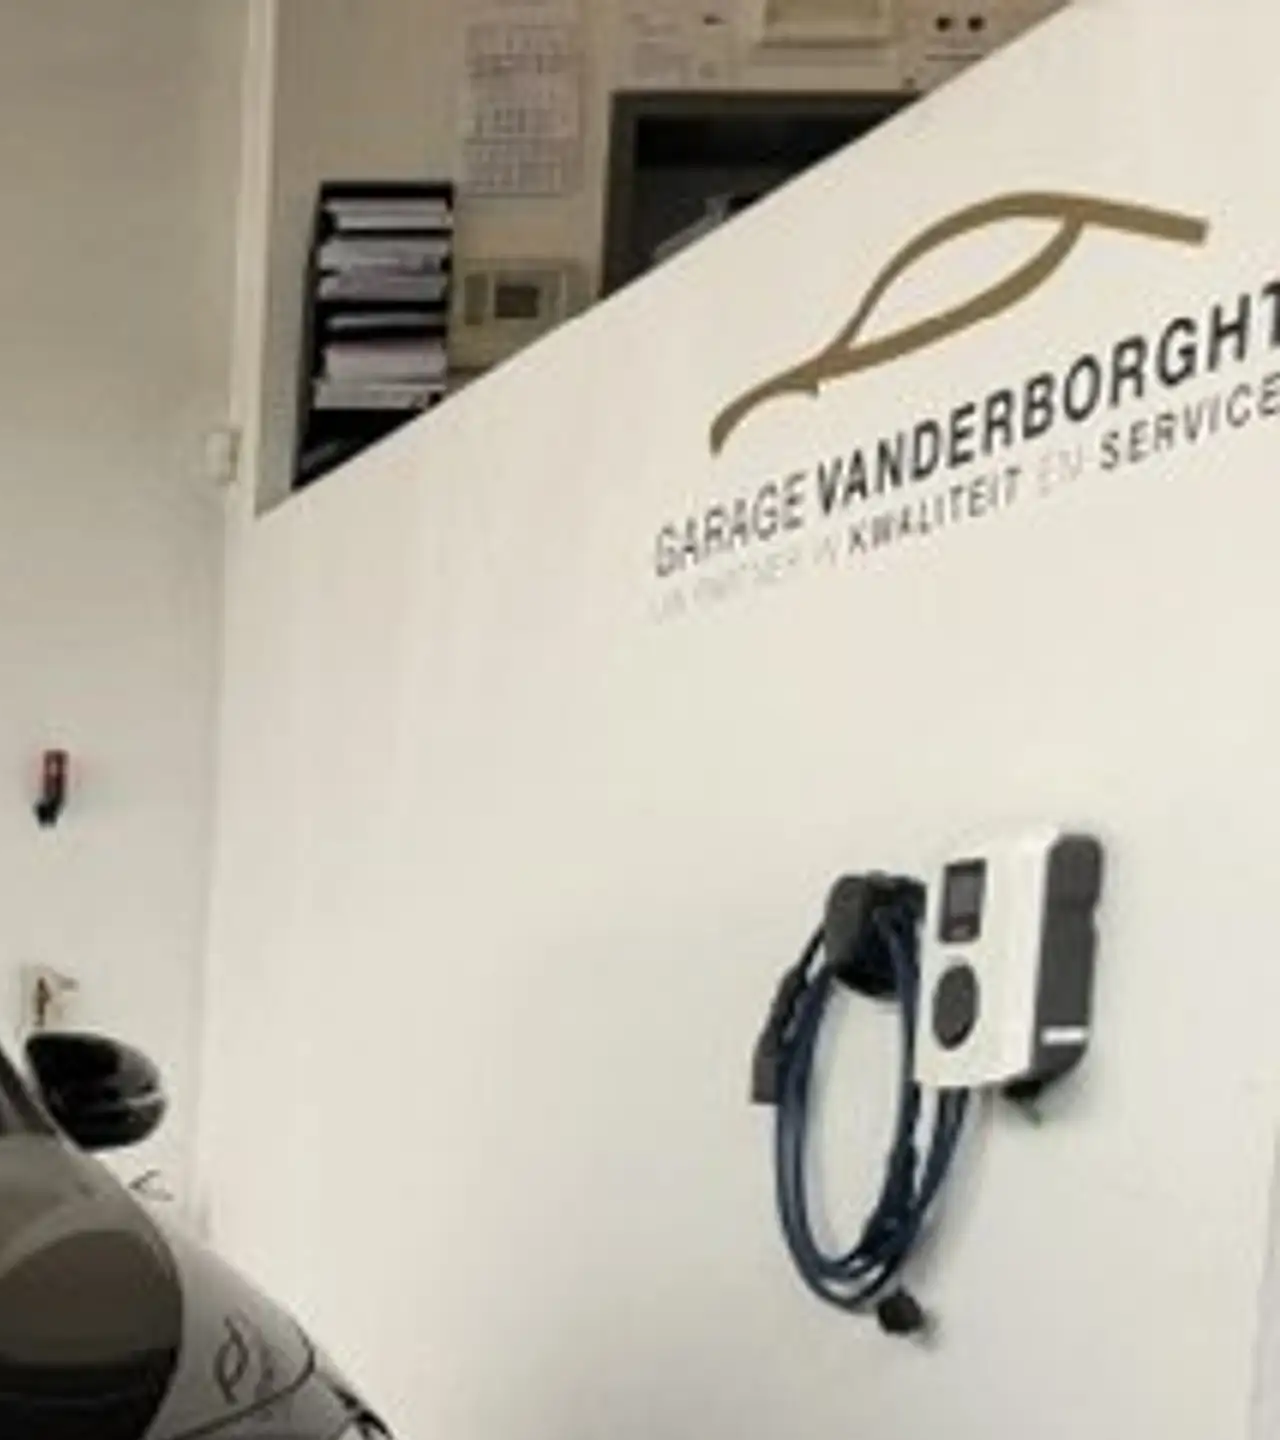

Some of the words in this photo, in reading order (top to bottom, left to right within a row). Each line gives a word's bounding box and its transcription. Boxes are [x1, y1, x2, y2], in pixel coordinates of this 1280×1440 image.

[654, 471, 806, 578] GARAGE
[816, 279, 1280, 515] VANDERBORGHT
[848, 467, 1022, 558] KWALITEIT
[1099, 372, 1280, 472] SERVICE
